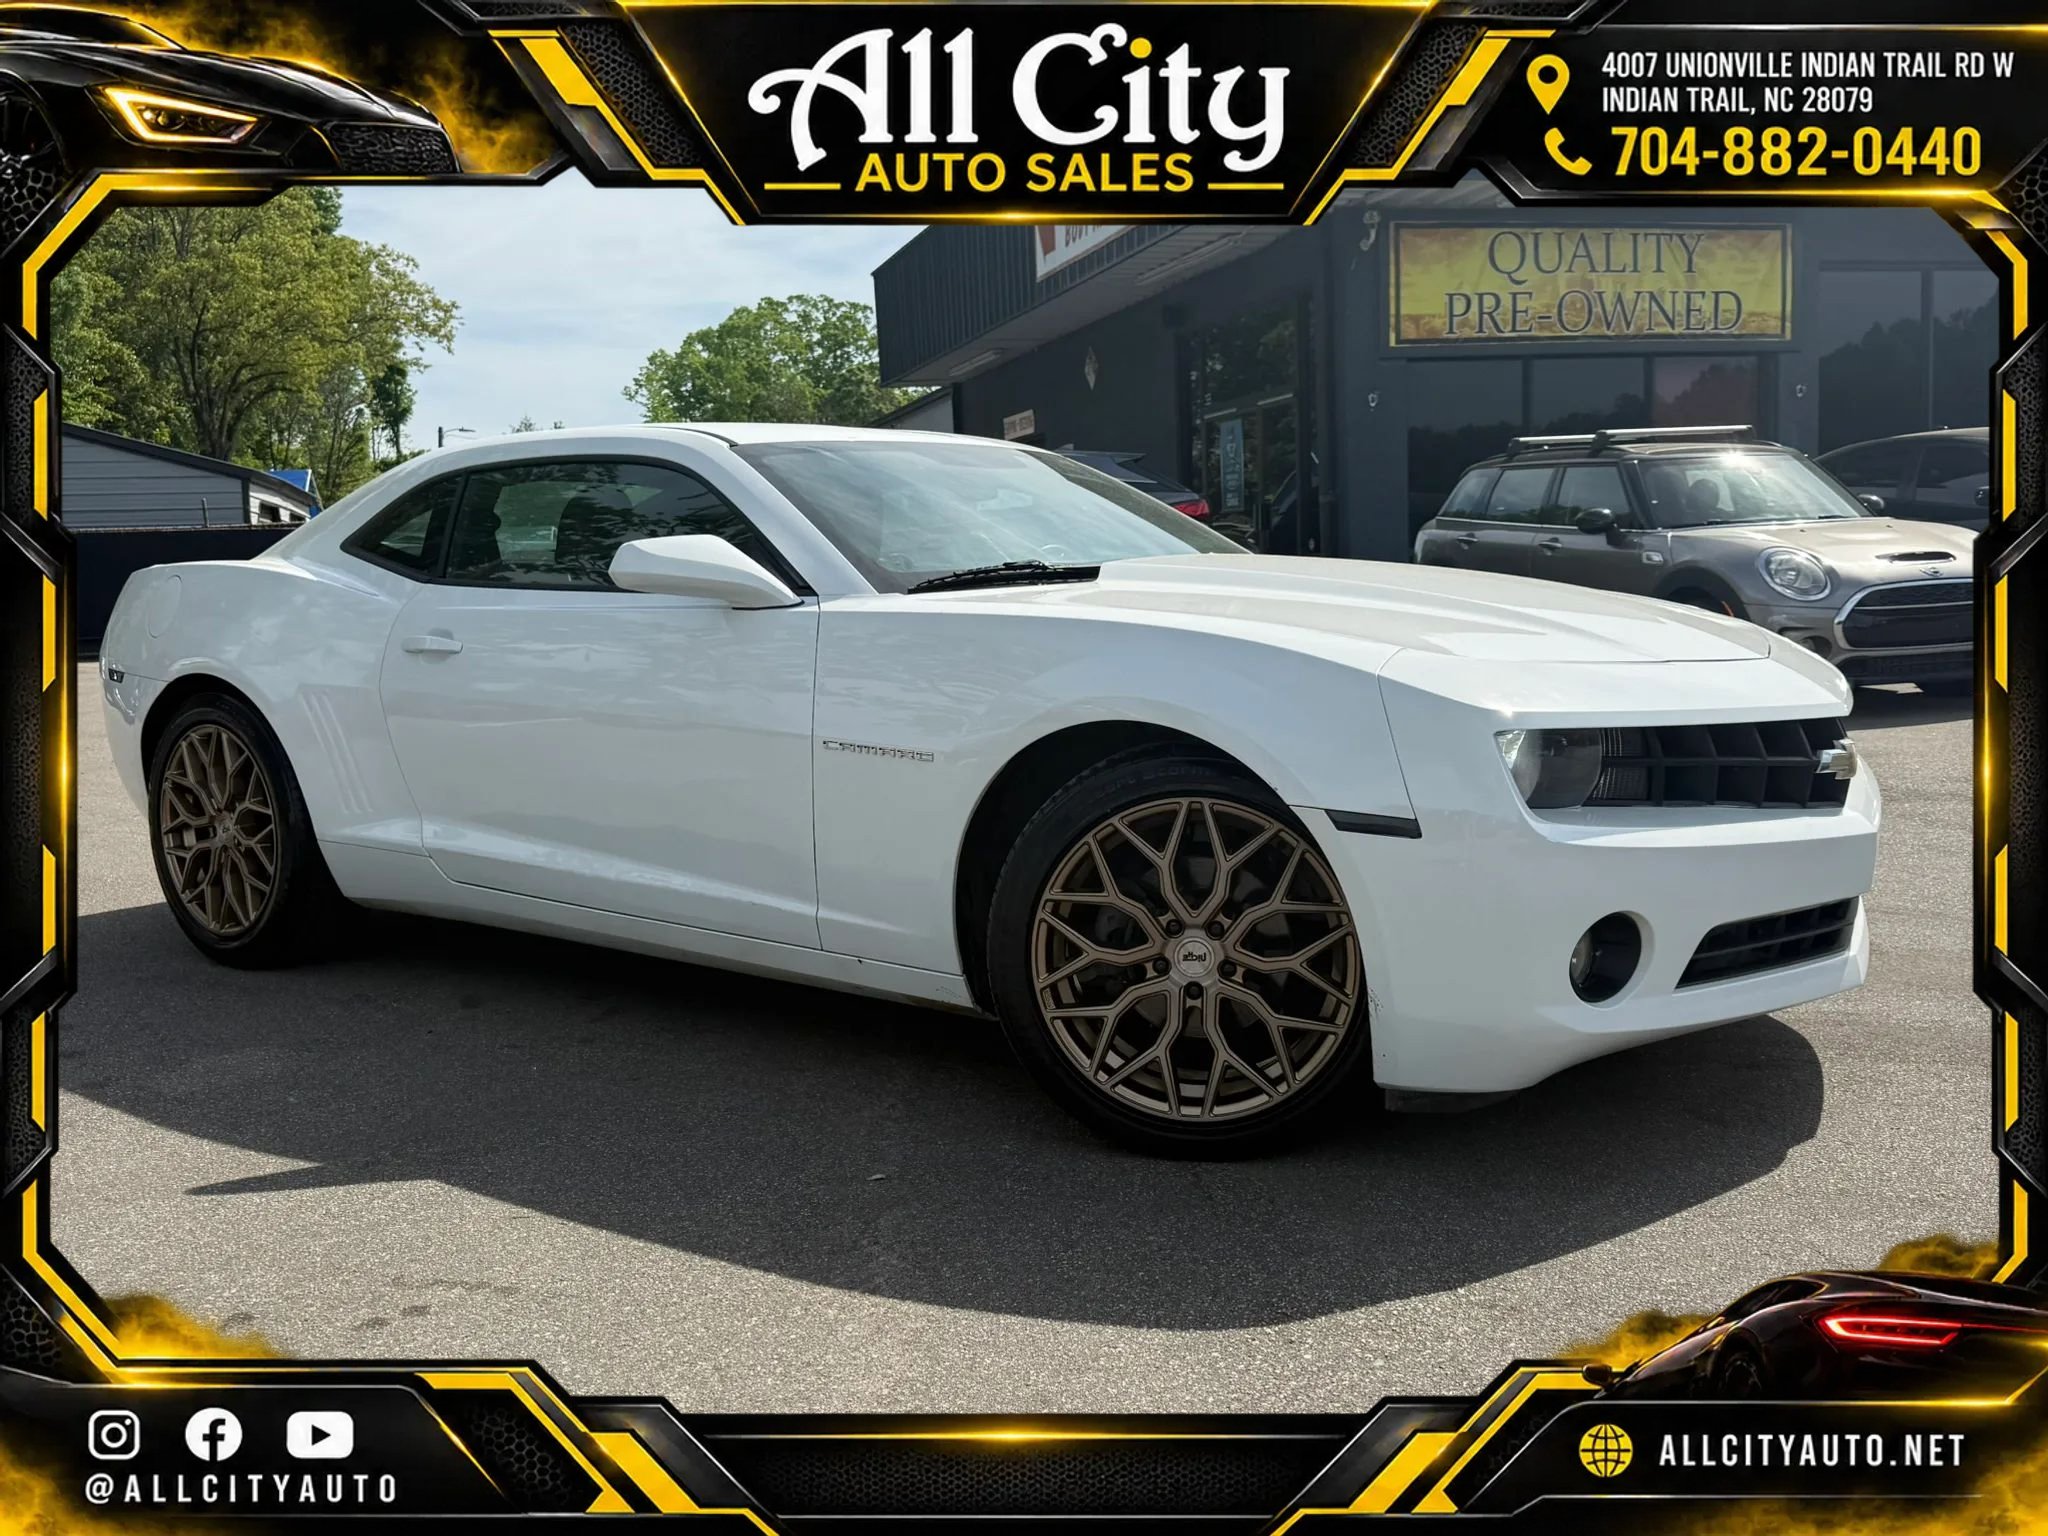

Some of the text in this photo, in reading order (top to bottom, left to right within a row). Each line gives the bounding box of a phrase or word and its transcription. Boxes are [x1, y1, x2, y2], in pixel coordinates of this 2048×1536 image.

[1488, 231, 1704, 285] QUALITY
[1444, 289, 1744, 335] PRE-OWNED
[822, 740, 934, 762] CAMARO
